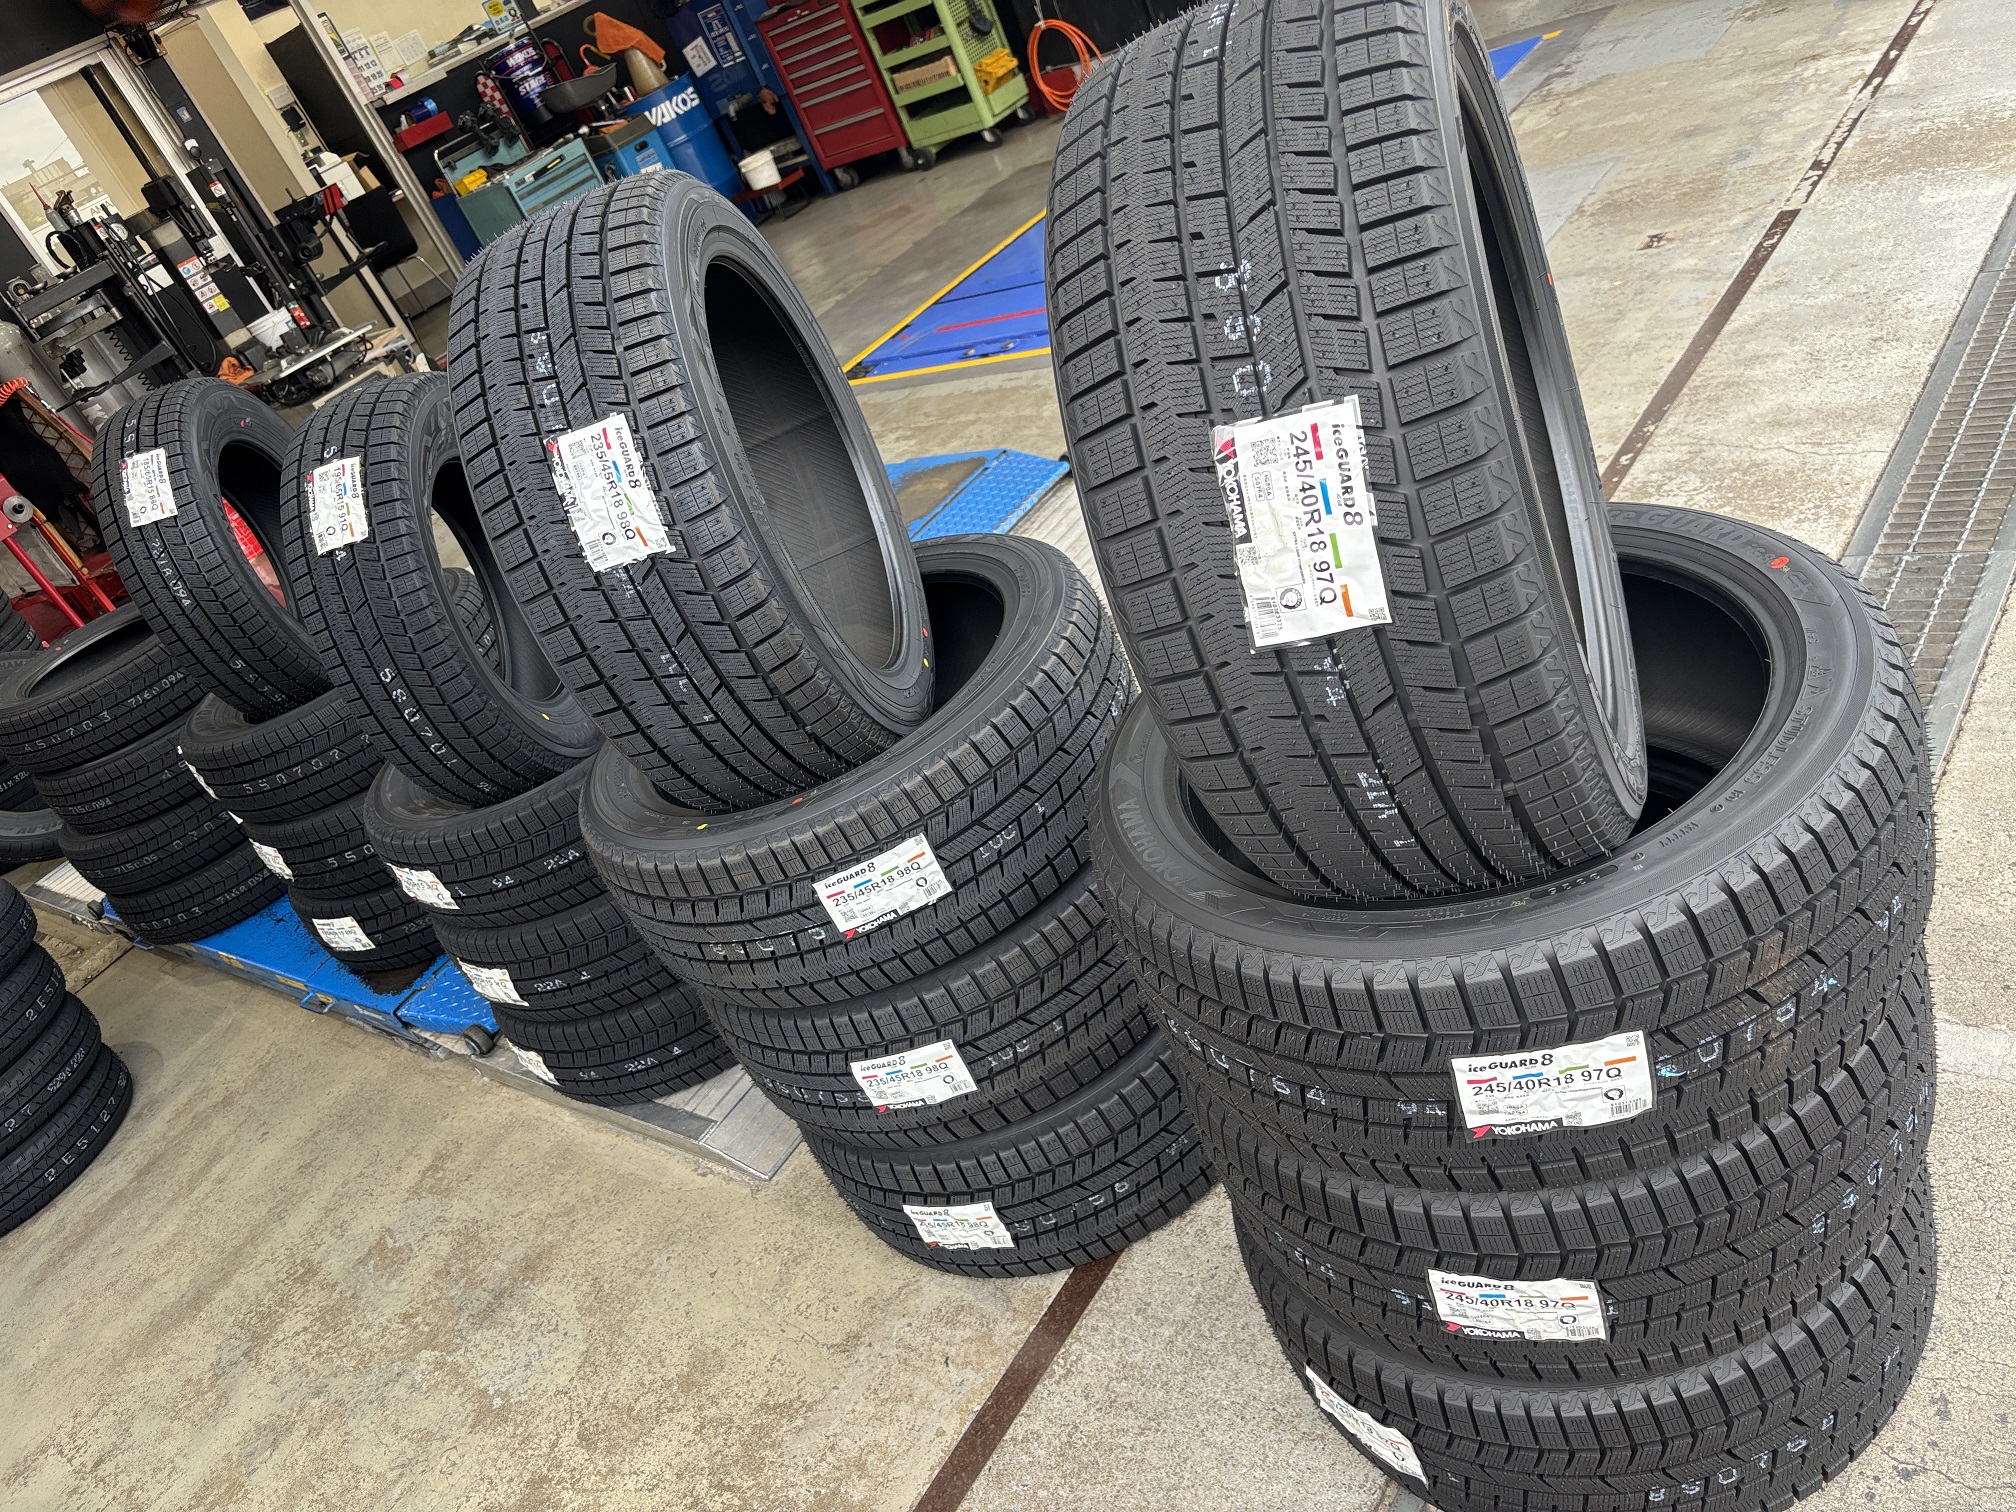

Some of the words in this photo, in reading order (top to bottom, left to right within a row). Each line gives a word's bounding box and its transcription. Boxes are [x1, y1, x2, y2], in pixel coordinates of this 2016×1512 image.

[143, 457, 156, 495] 185/65R15
[333, 467, 345, 511] 195/65R15
[552, 456, 577, 510] YOKOHAMA
[590, 433, 624, 508] 235/45R18
[617, 511, 636, 541] 98Q
[149, 494, 159, 511] 88Q
[1221, 462, 1248, 538] YOKOHAMA
[338, 511, 349, 534] 91Q
[1289, 431, 1328, 553] 245/40R18
[1313, 561, 1337, 605] 97Q
[1751, 706, 1813, 784] STUDLESS
[1117, 797, 1197, 888] YOKOHAMA
[825, 868, 867, 889] iceGUARD
[867, 862, 876, 873] 8
[832, 875, 895, 907] 235/45R18
[896, 861, 922, 879] 98Q
[856, 911, 898, 934] YOKOHAMA
[861, 1060, 897, 1071] iceGUARD
[898, 1055, 906, 1066] 8
[867, 1070, 924, 1088] 235/45R18
[925, 1062, 950, 1074] 98Q
[1467, 1058, 1539, 1073] iceGUARD
[1541, 1053, 1554, 1066] 8
[1472, 1073, 1574, 1097] 245/40R18
[1582, 1067, 1623, 1083] 97Q
[44, 1096, 118, 1182] 2E5127
[1491, 1120, 1558, 1136] YOKOHAMA
[1446, 1291, 1534, 1308] 245/40R18
[1541, 1299, 1577, 1310] 97Q
[1462, 1327, 1520, 1339] YOKOHAMA
